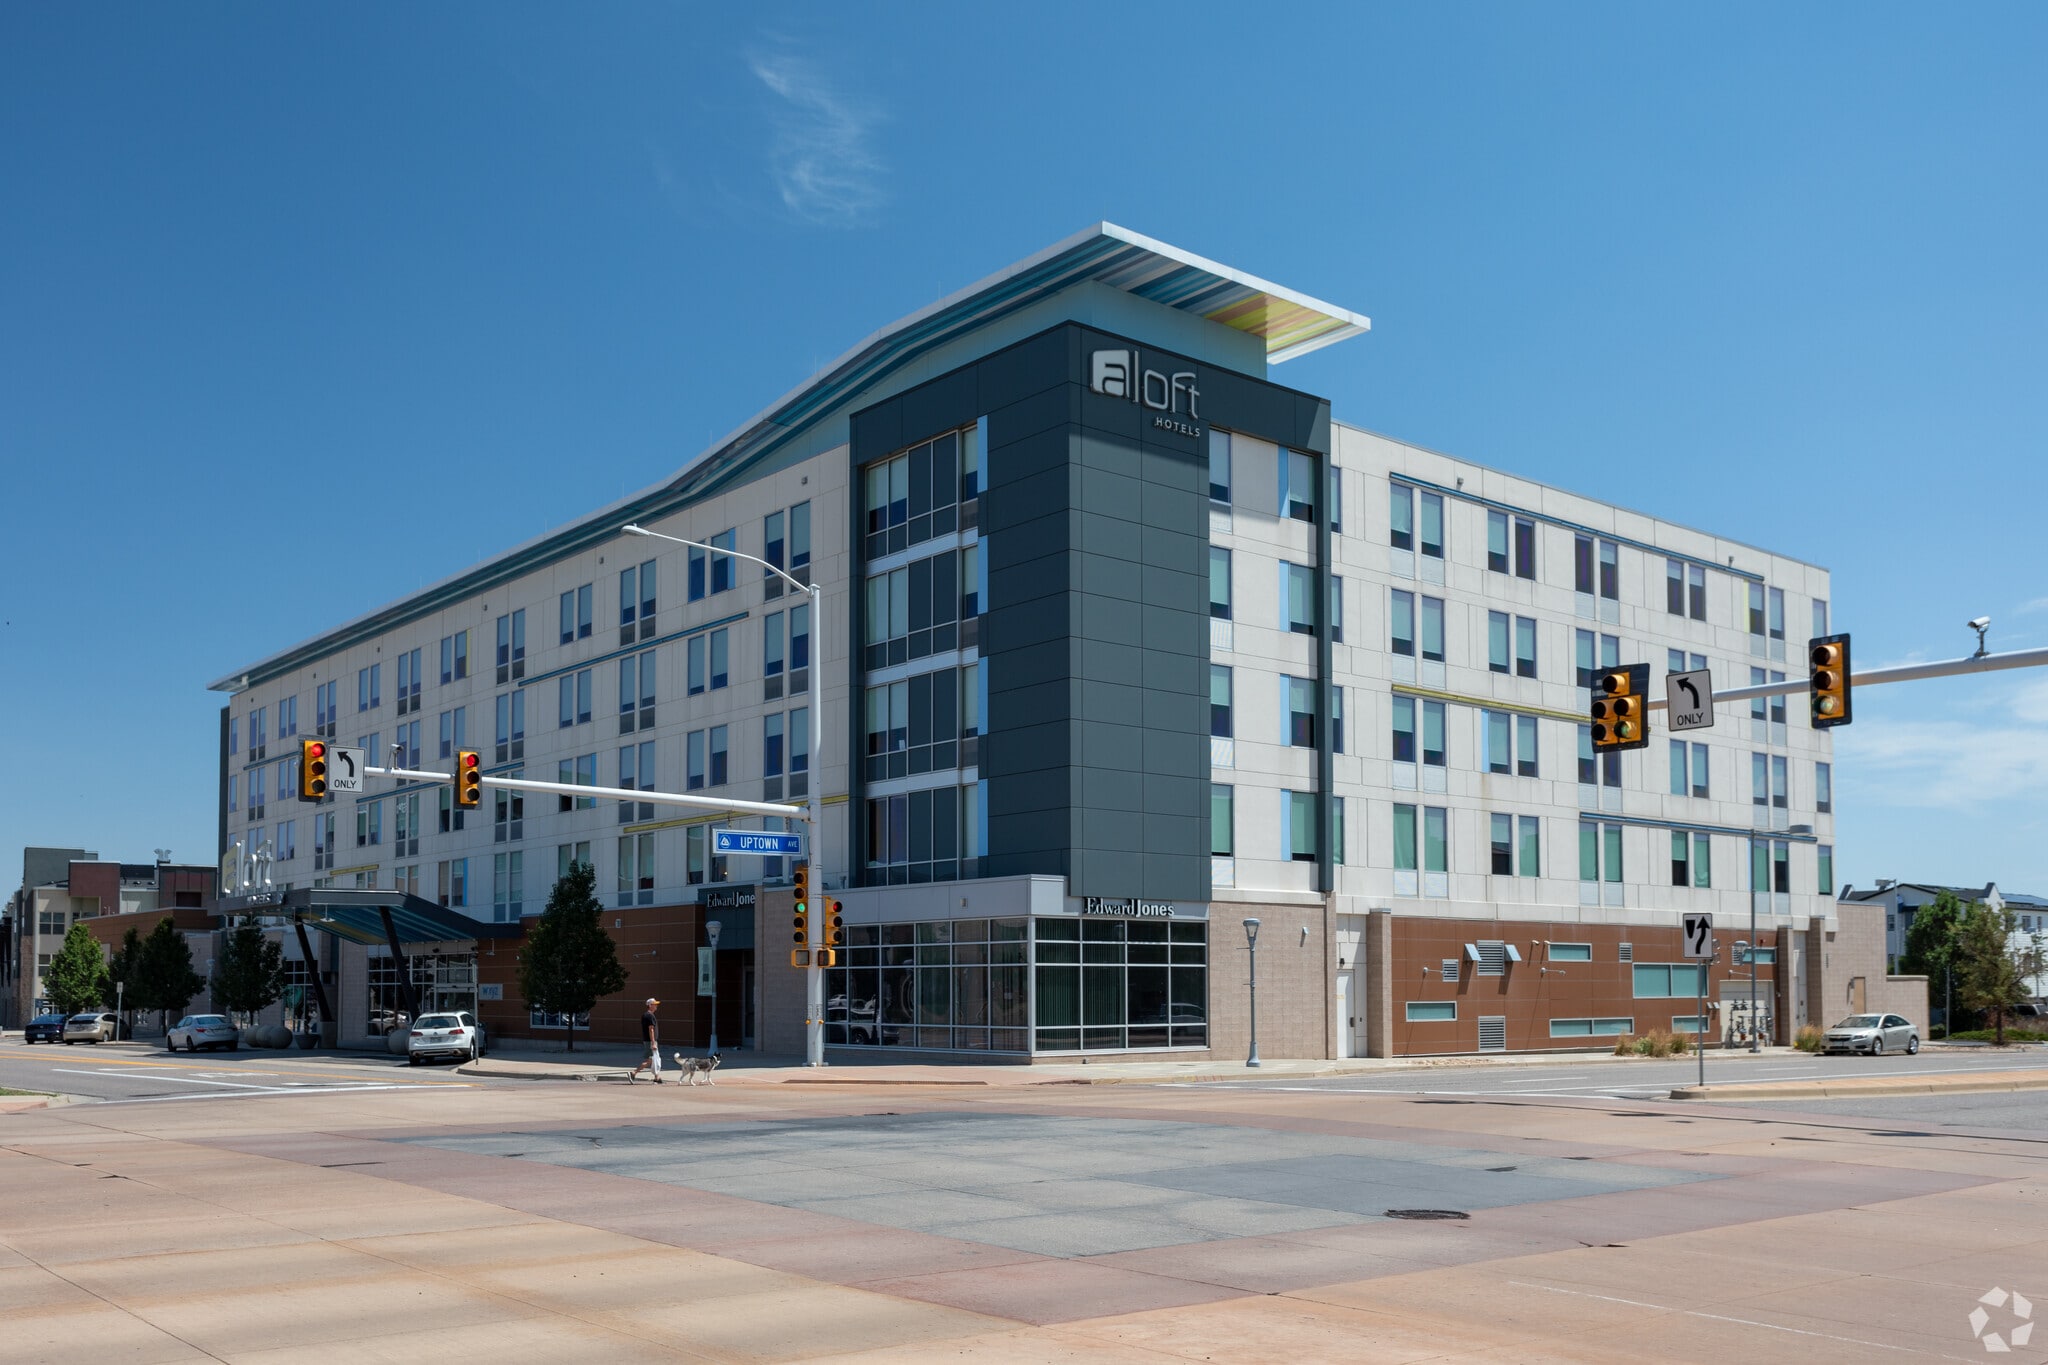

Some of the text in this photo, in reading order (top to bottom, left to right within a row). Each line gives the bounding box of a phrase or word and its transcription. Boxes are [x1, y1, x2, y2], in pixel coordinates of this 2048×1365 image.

[1093, 349, 1200, 419] aloft
[1156, 417, 1200, 437] HOTELS
[1677, 712, 1704, 726] ONLY
[334, 779, 357, 789] ONLY
[740, 836, 798, 850] UPTOWN AVE
[707, 891, 755, 908] Edward Jone
[1086, 897, 1175, 918] Edward Jones
